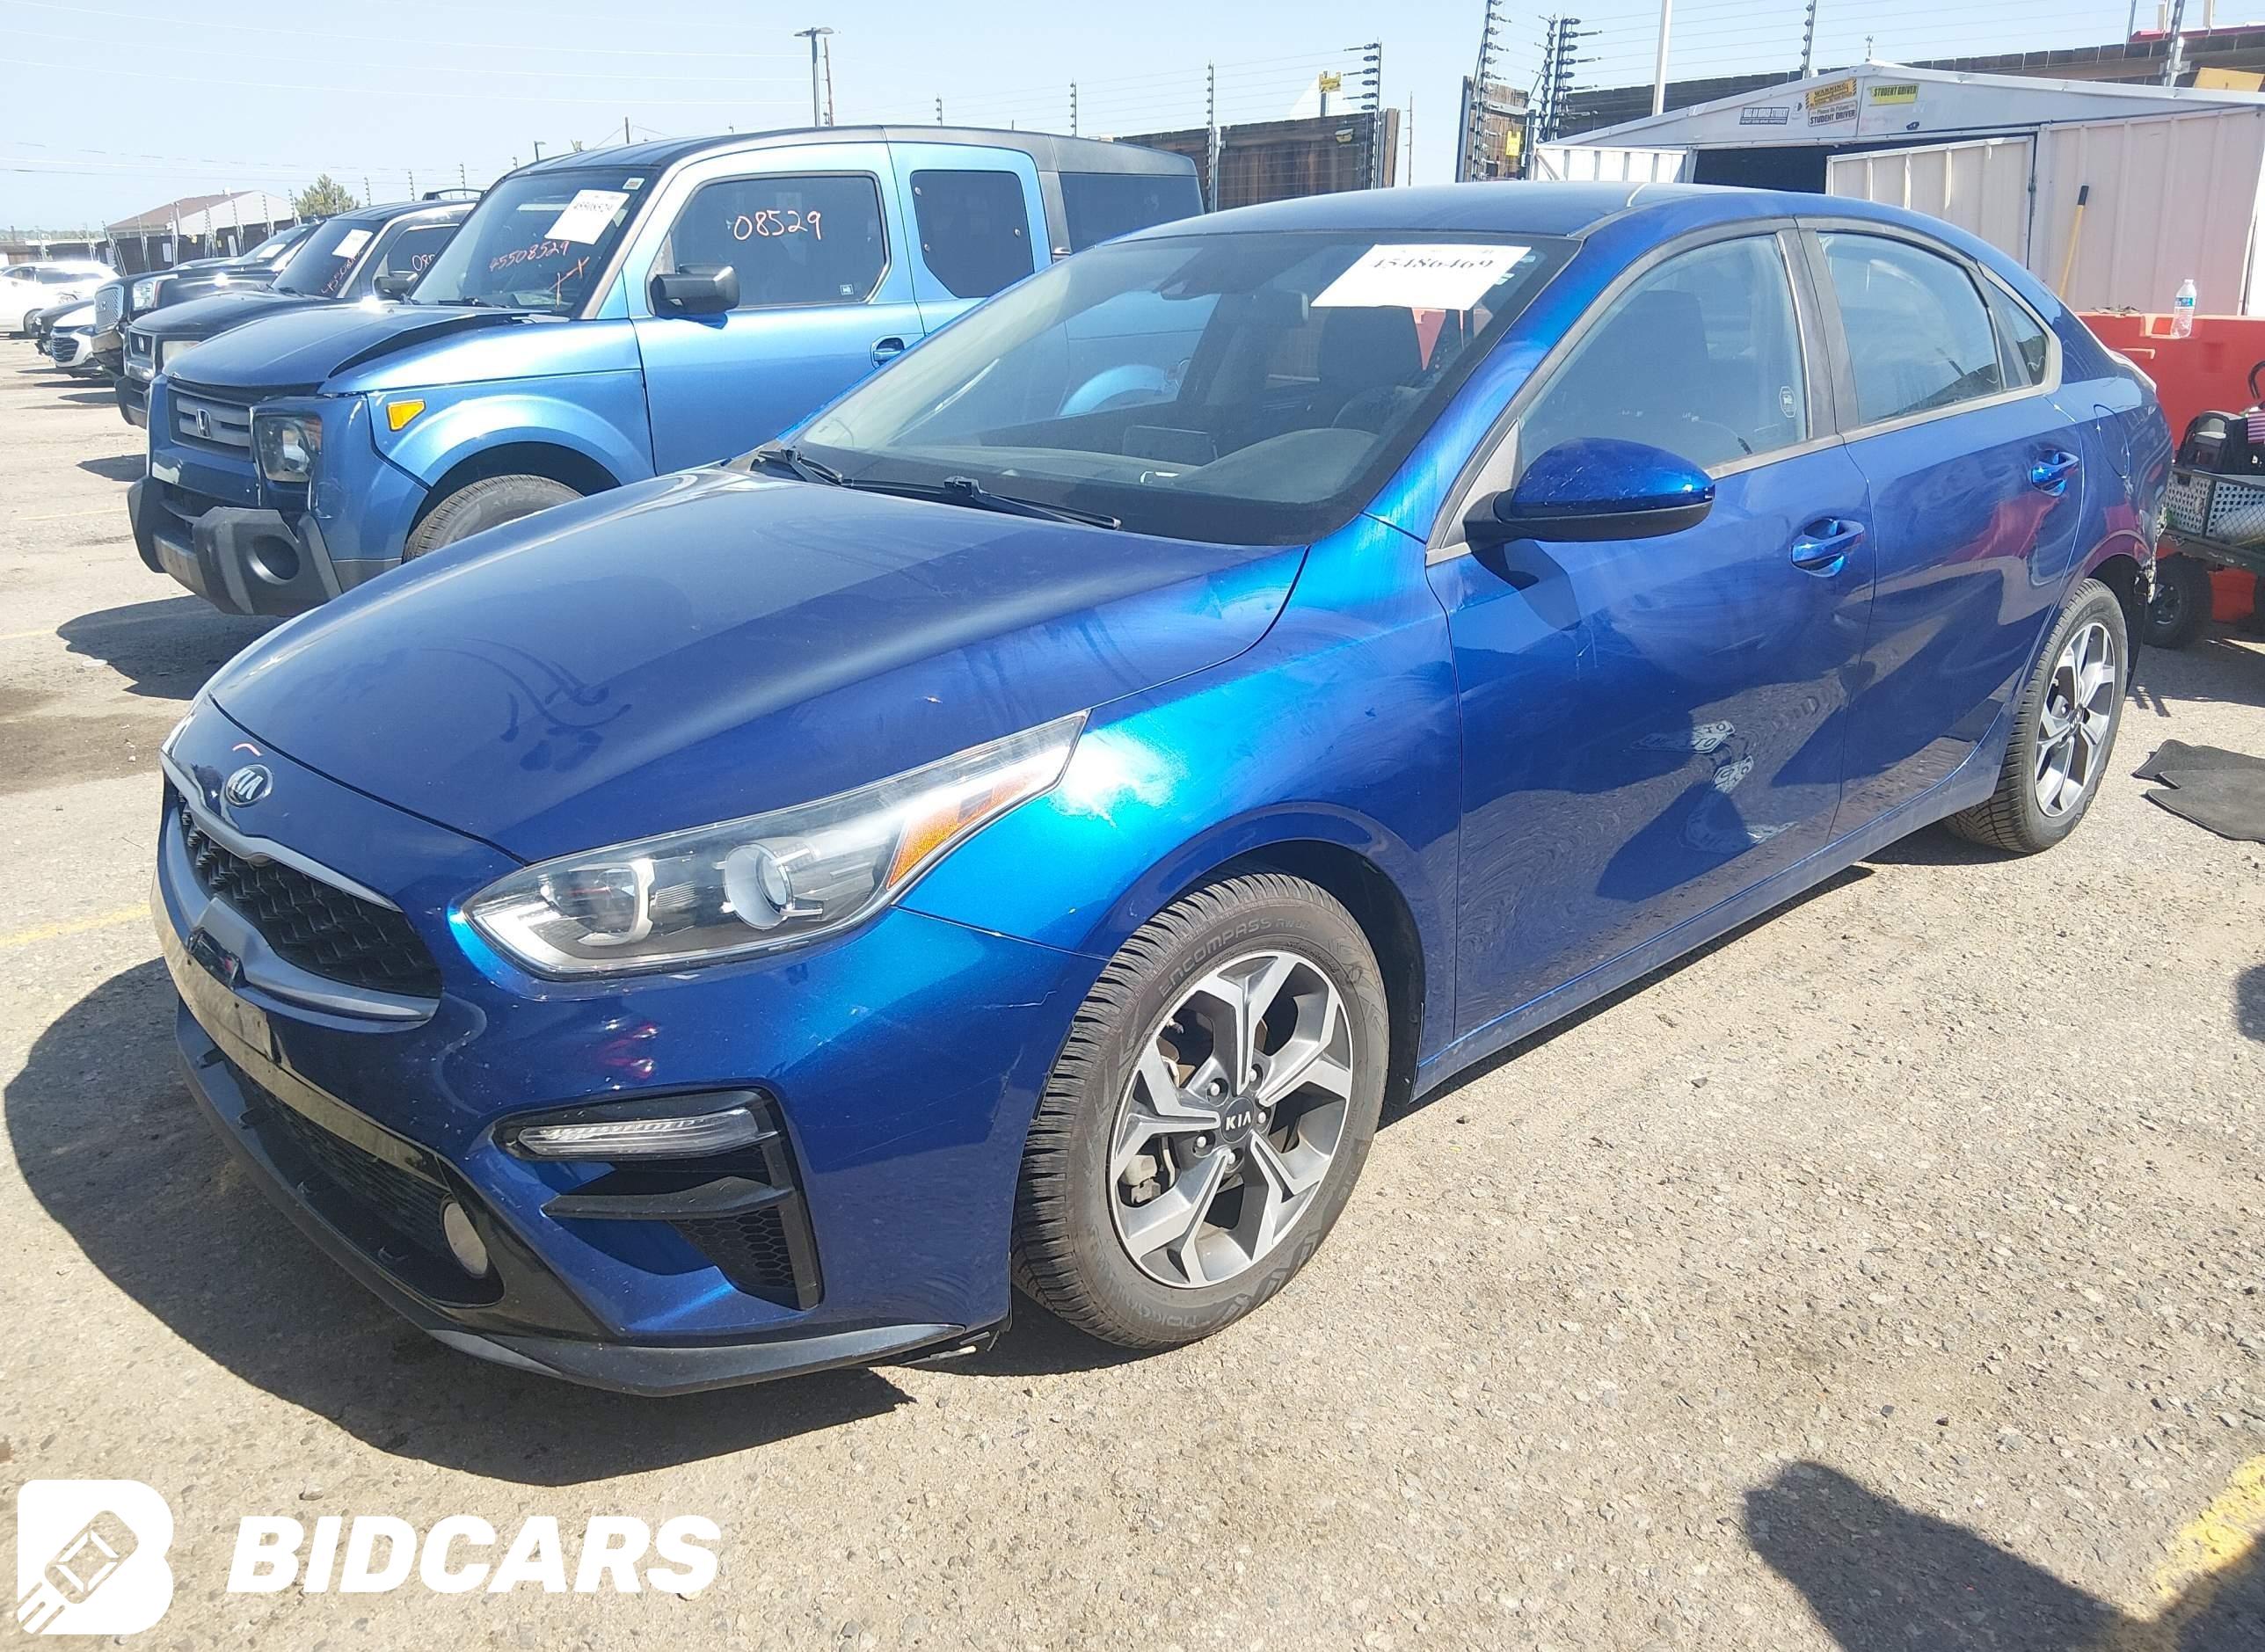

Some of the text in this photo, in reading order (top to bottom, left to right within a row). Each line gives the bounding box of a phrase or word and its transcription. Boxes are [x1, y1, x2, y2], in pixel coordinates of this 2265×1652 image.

[1874, 85, 1917, 97] STUDENT DRIVER
[1810, 109, 1855, 125] STUDENT DRIVER
[734, 210, 821, 240] 08529
[229, 768, 264, 800] KIA
[1225, 1110, 1251, 1131] KIA
